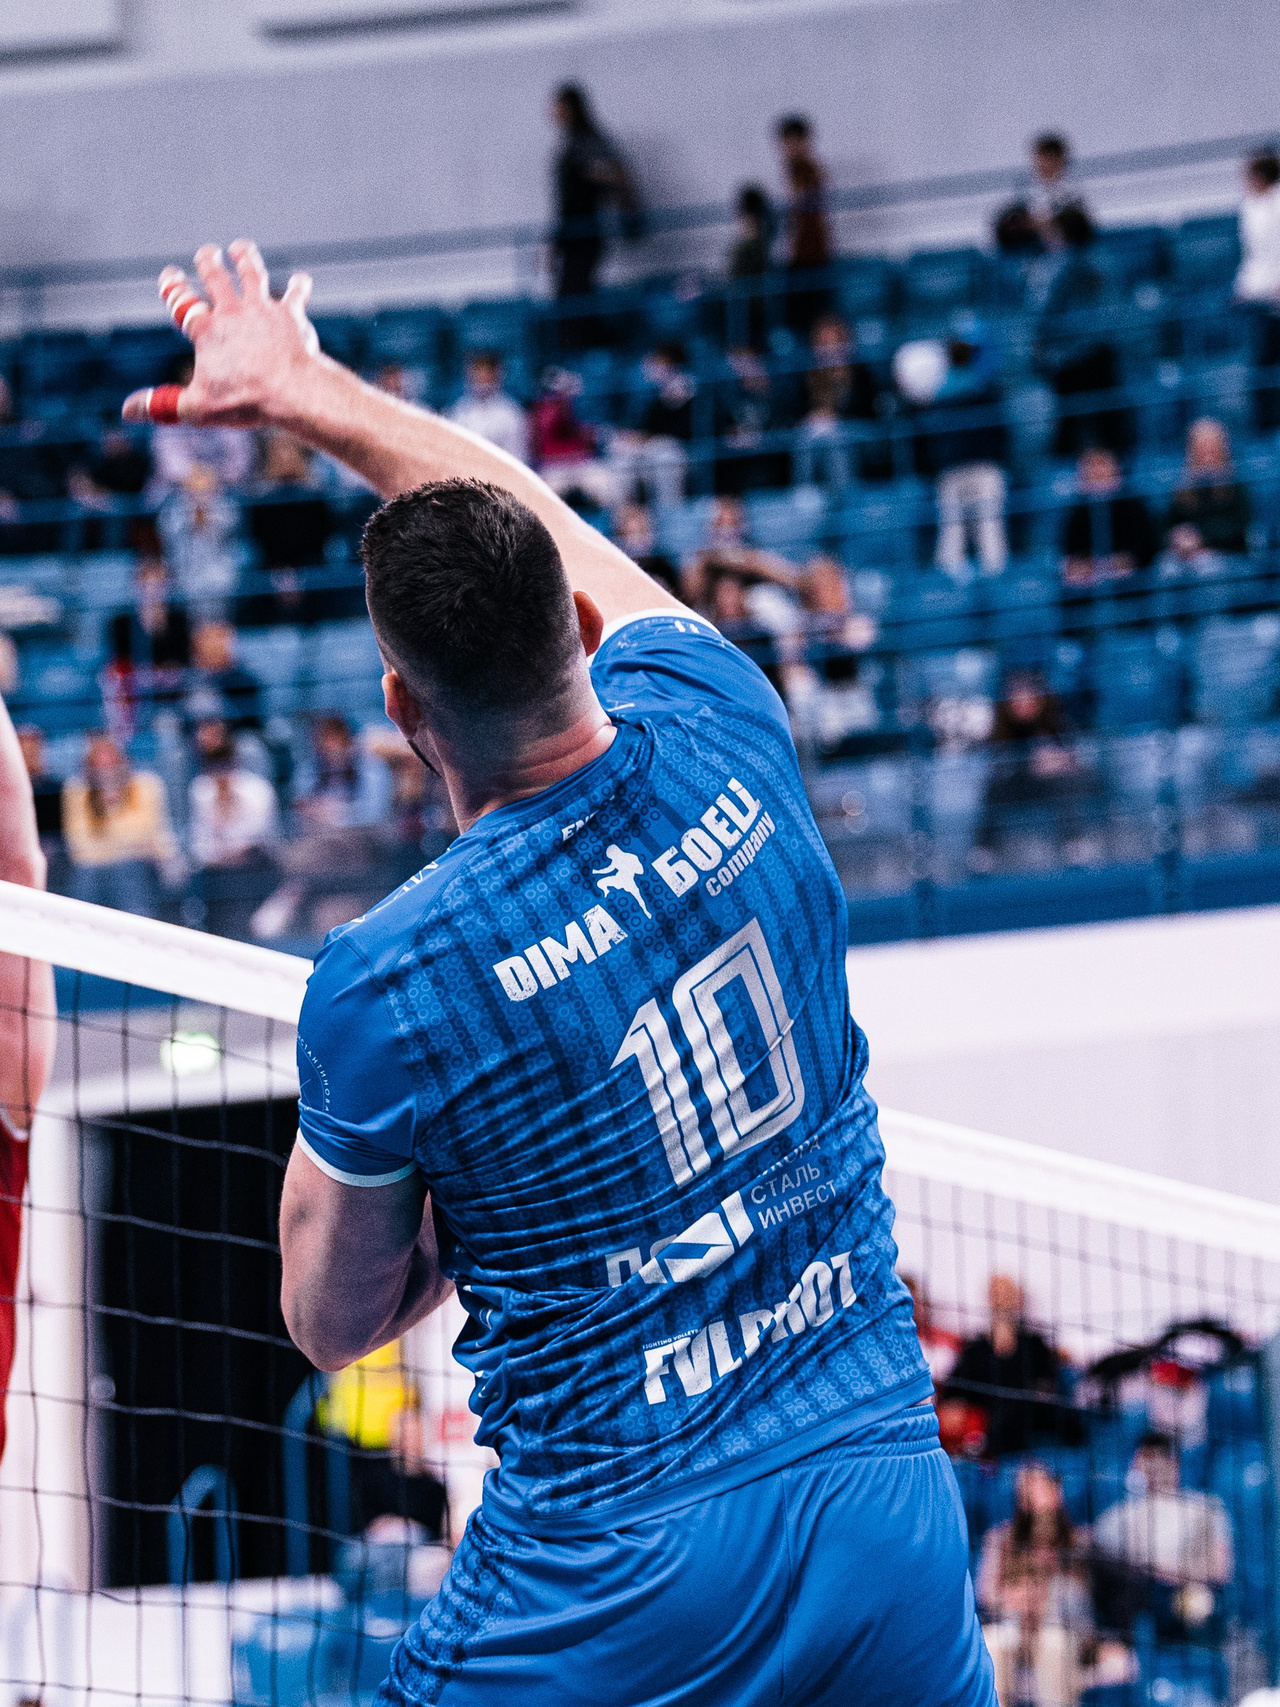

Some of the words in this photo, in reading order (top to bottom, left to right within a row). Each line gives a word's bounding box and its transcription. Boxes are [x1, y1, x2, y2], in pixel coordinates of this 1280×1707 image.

[705, 811, 776, 897] company
[492, 904, 629, 1002] DIMA
[609, 916, 806, 1190] 10
[750, 1162, 821, 1205] СТАЛЬ
[757, 1178, 838, 1230] ИНВЕСТ
